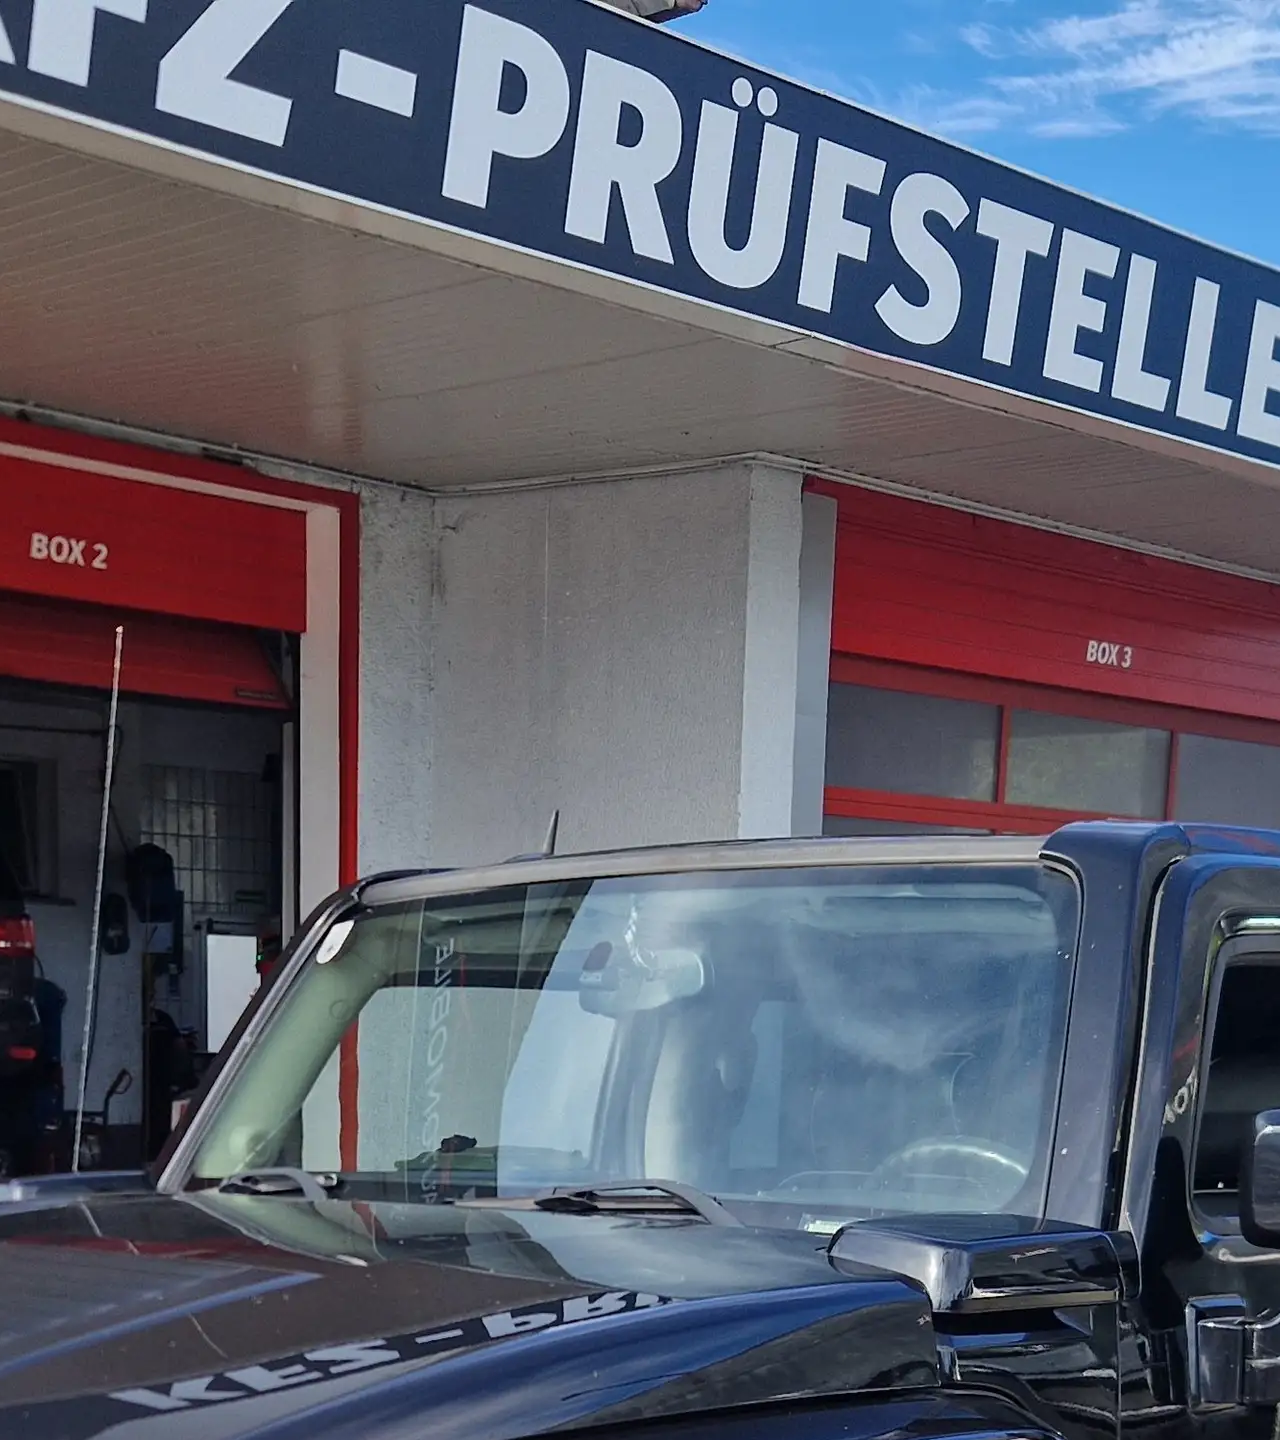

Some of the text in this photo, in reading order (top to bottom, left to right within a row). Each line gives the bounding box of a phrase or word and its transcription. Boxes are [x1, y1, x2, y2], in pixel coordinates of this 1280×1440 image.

[29, 532, 108, 570] BOX 2
[1086, 640, 1132, 668] BOX 3
